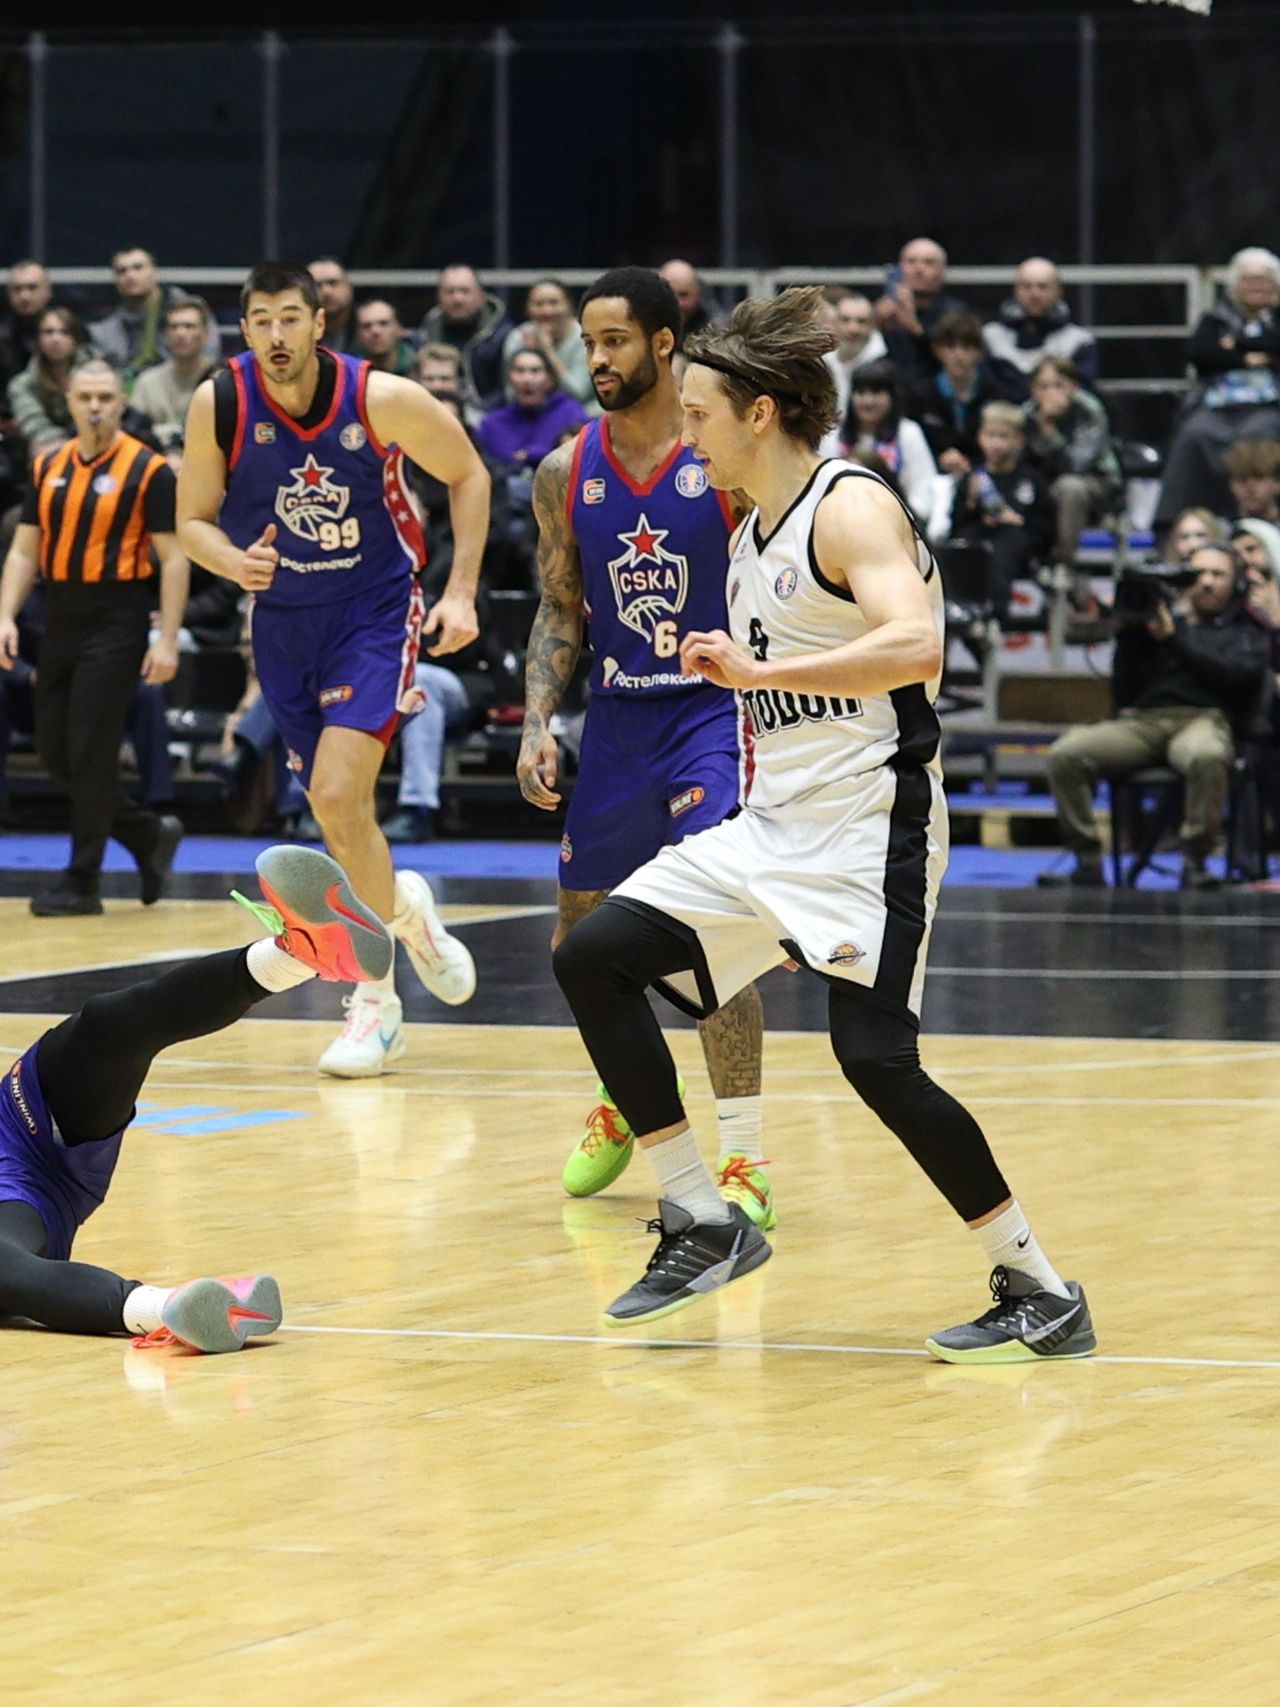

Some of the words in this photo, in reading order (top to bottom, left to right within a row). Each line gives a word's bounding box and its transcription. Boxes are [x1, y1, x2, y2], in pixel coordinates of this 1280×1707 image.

[319, 517, 360, 551] 99
[620, 568, 677, 593] CSKA
[654, 620, 678, 658] 6
[12, 1077, 35, 1128] WINLINE
